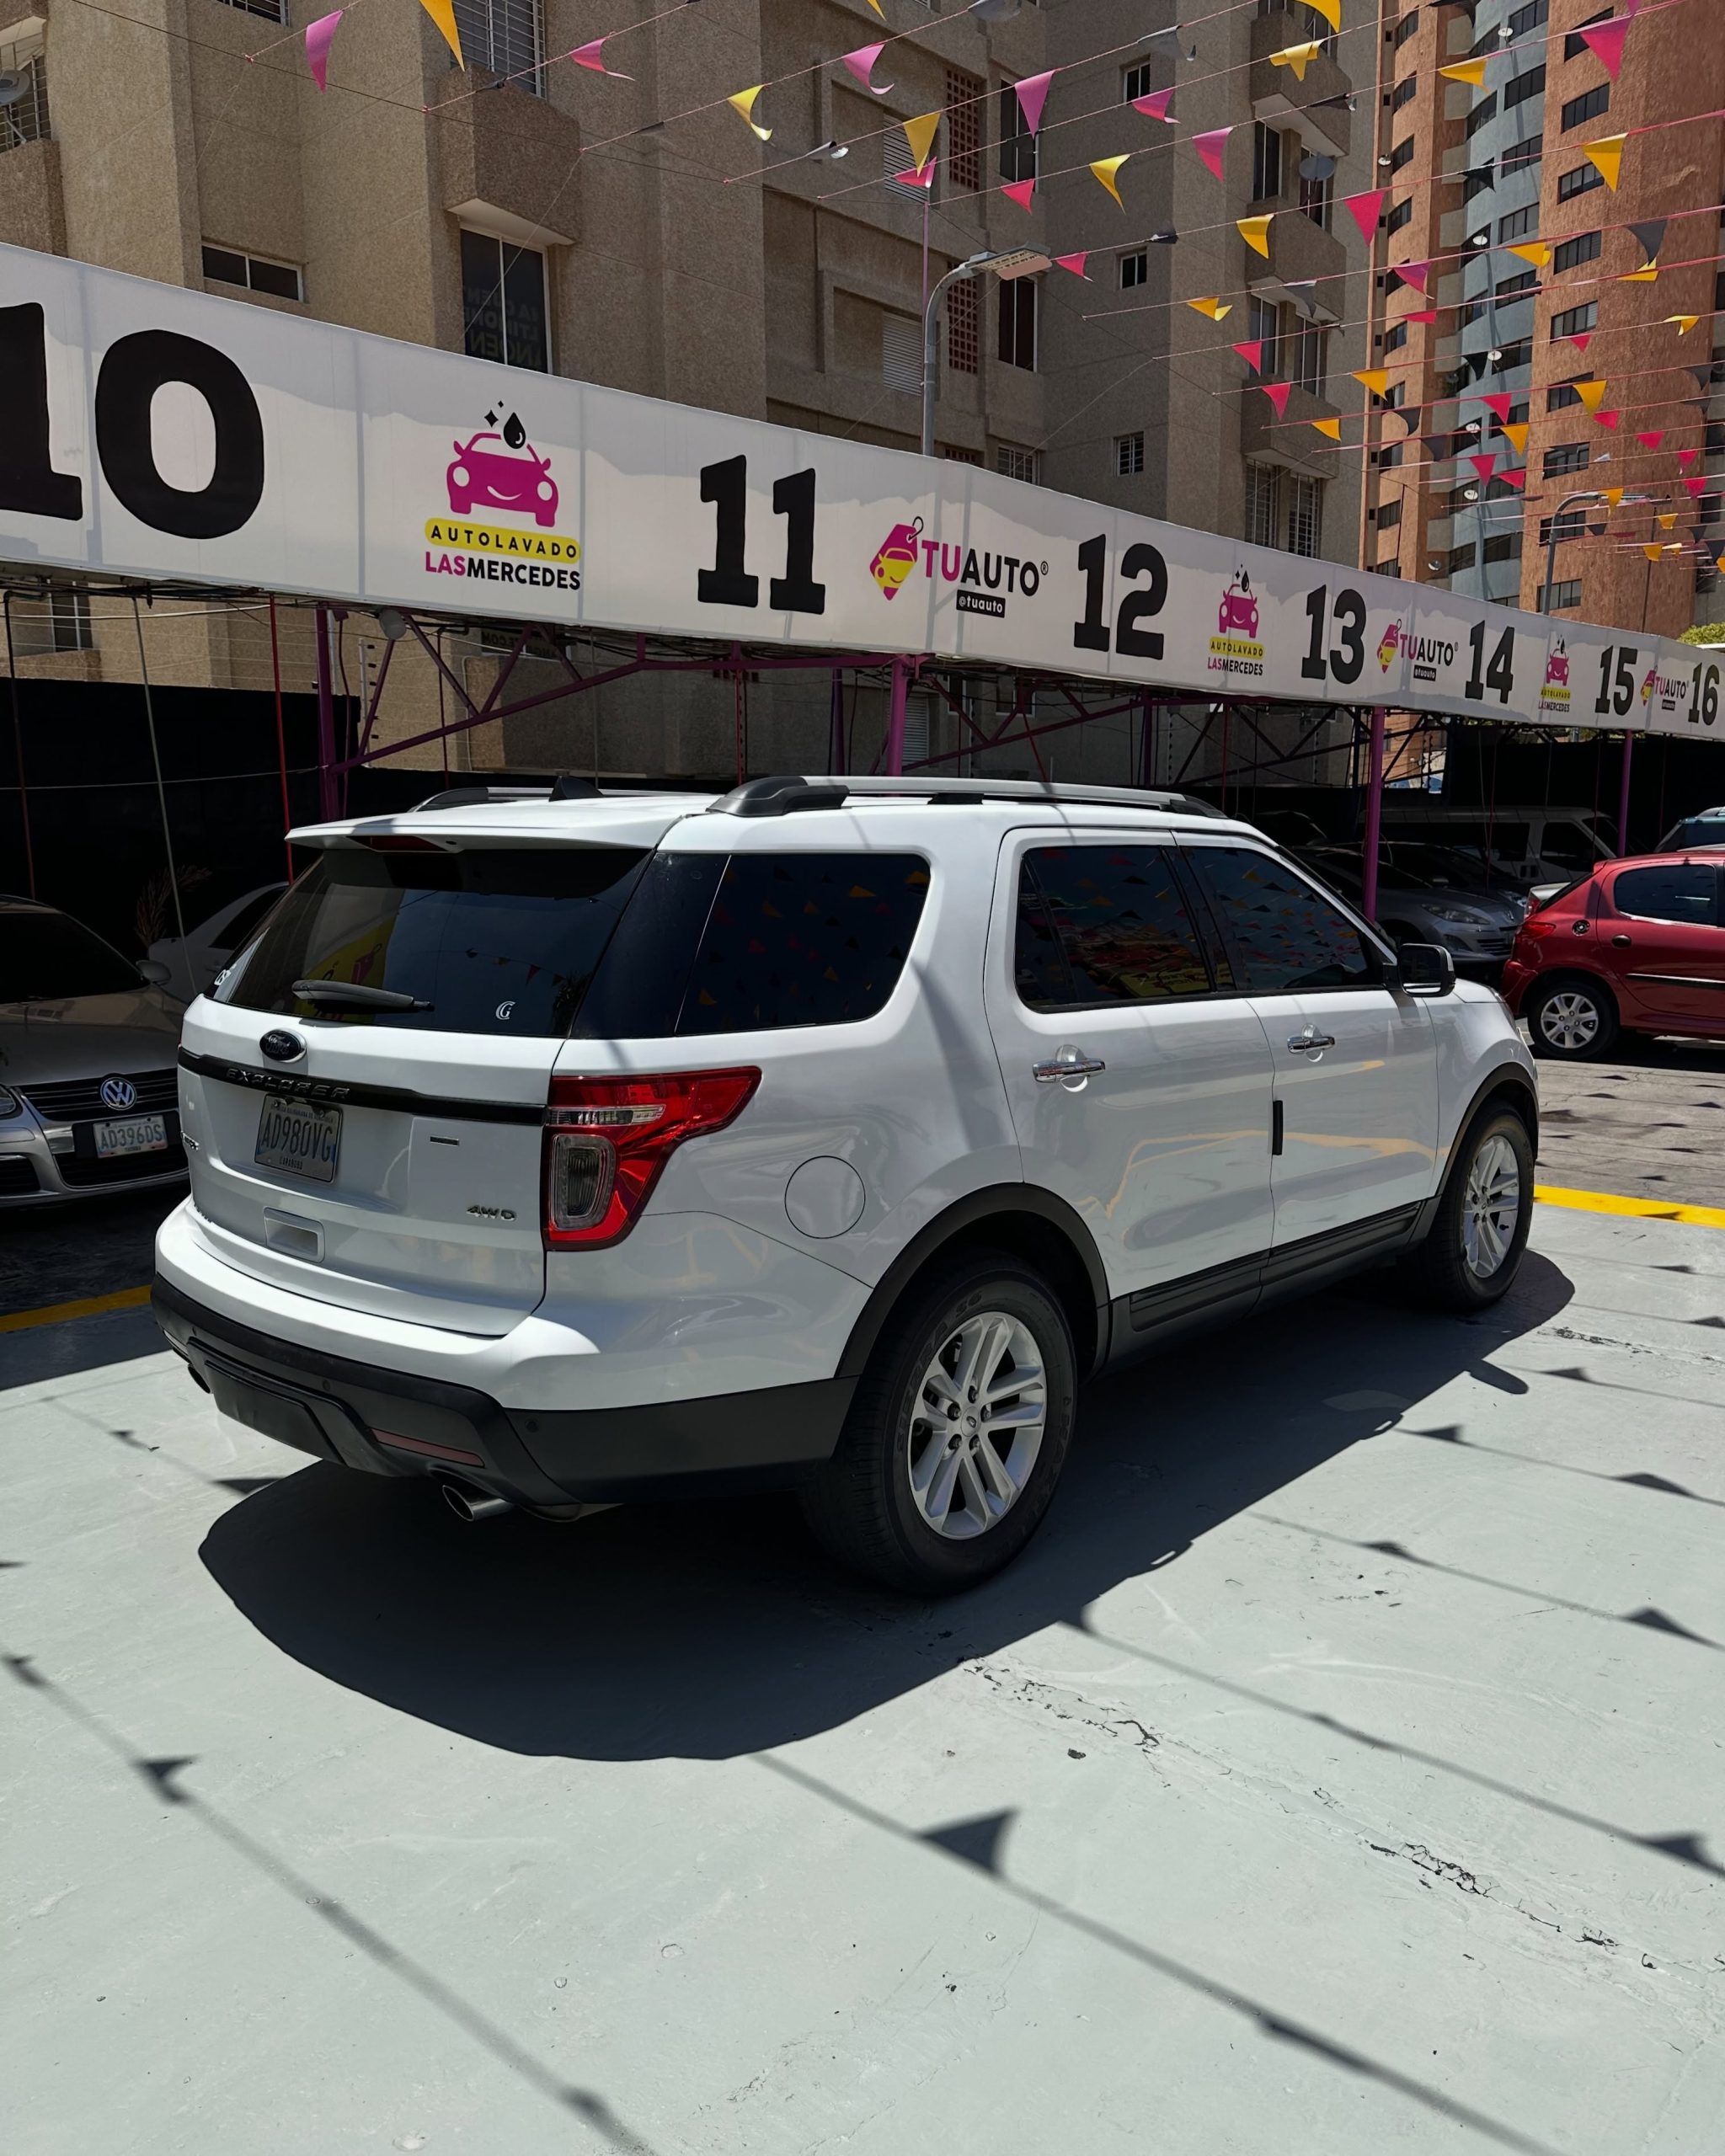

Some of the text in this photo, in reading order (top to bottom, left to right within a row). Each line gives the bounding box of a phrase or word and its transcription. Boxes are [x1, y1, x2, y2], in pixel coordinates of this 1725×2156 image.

[0, 302, 264, 540] 10
[430, 525, 577, 558] AUTOLAVADO
[698, 455, 826, 616] 11
[959, 595, 1003, 613] @tuauto
[1074, 534, 1168, 660] 12
[1210, 641, 1263, 657] AUTOLAVADO
[1301, 585, 1366, 684] 13
[1465, 621, 1514, 703] 14
[1595, 645, 1637, 715] 15
[1688, 662, 1720, 726] 16
[226, 1067, 351, 1099] EXPLORER
[101, 1124, 163, 1149] AD396DS
[261, 1113, 333, 1162] AD980VG
[467, 1204, 517, 1222] 4WD
